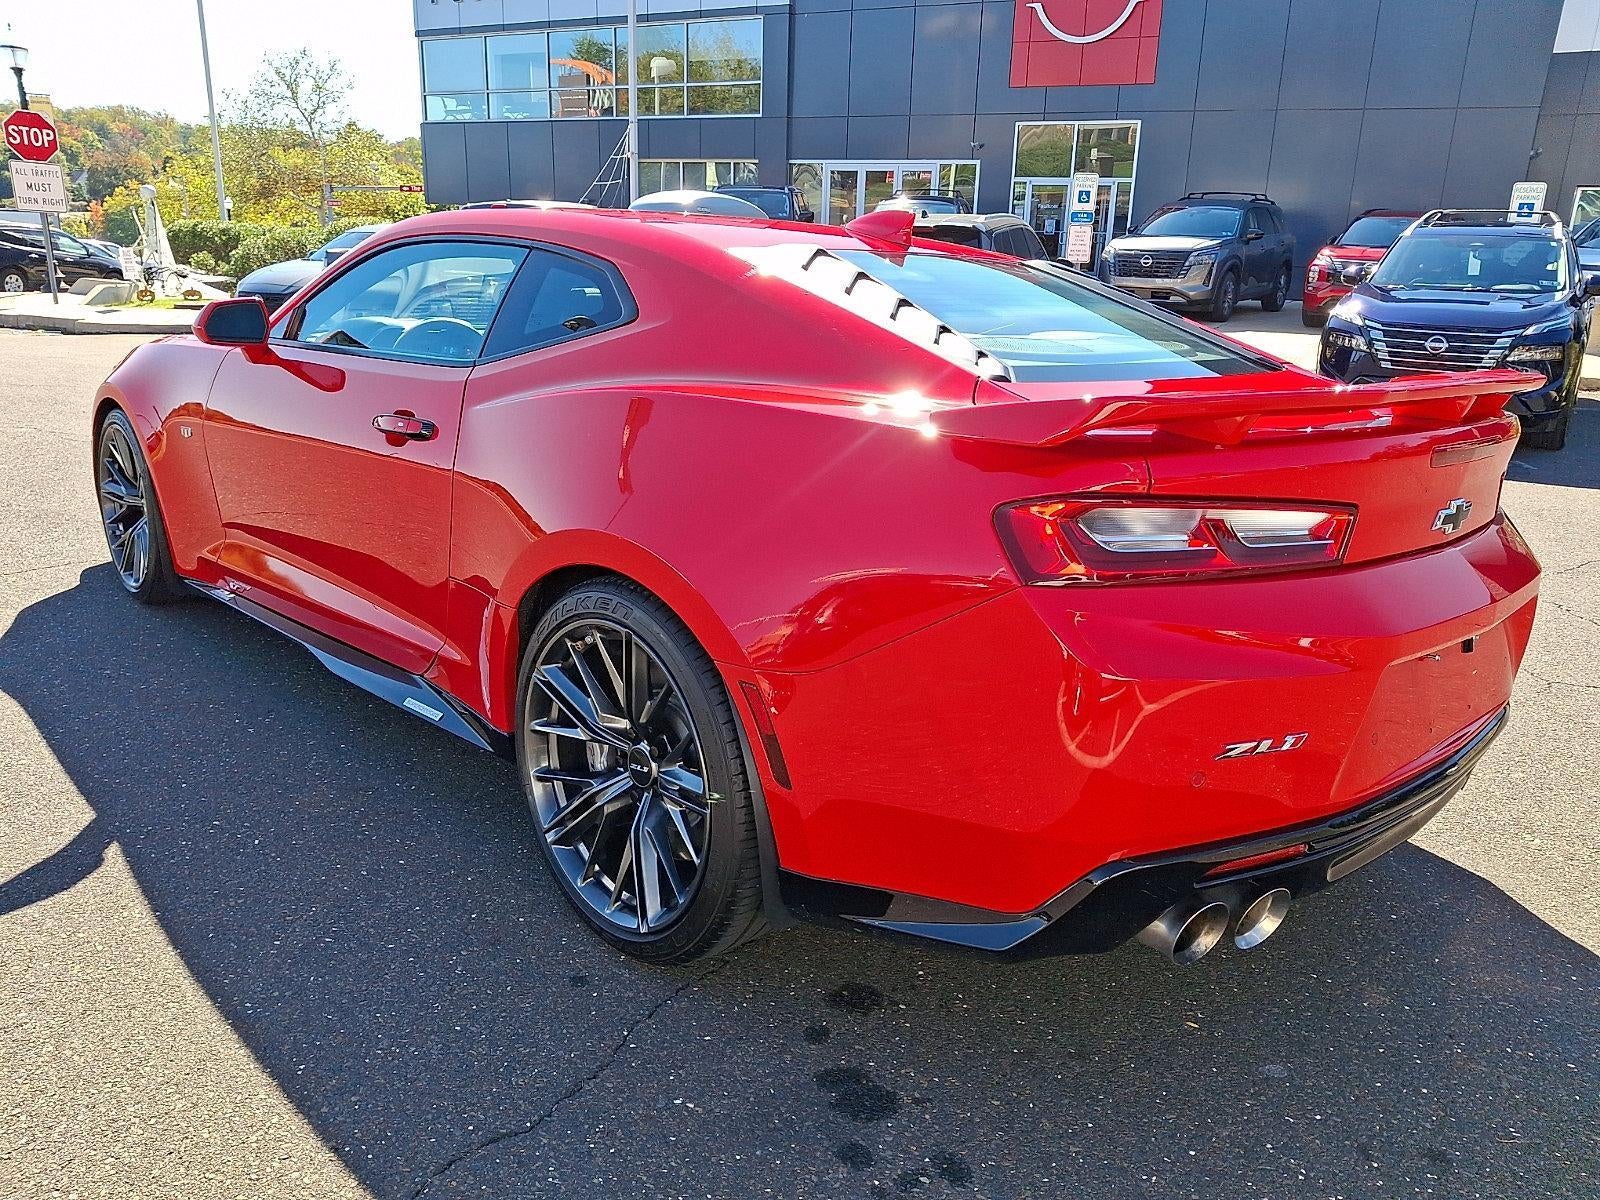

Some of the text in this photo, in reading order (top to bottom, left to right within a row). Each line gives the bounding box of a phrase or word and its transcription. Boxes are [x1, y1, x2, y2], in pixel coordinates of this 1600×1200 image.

[7, 124, 55, 148] STOP
[15, 167, 60, 179] ALL TRAFFIC
[25, 181, 52, 193] MUST
[17, 196, 65, 207] TURN RIGHT
[536, 594, 634, 643] FALKEN
[1214, 732, 1309, 761] ZL1
